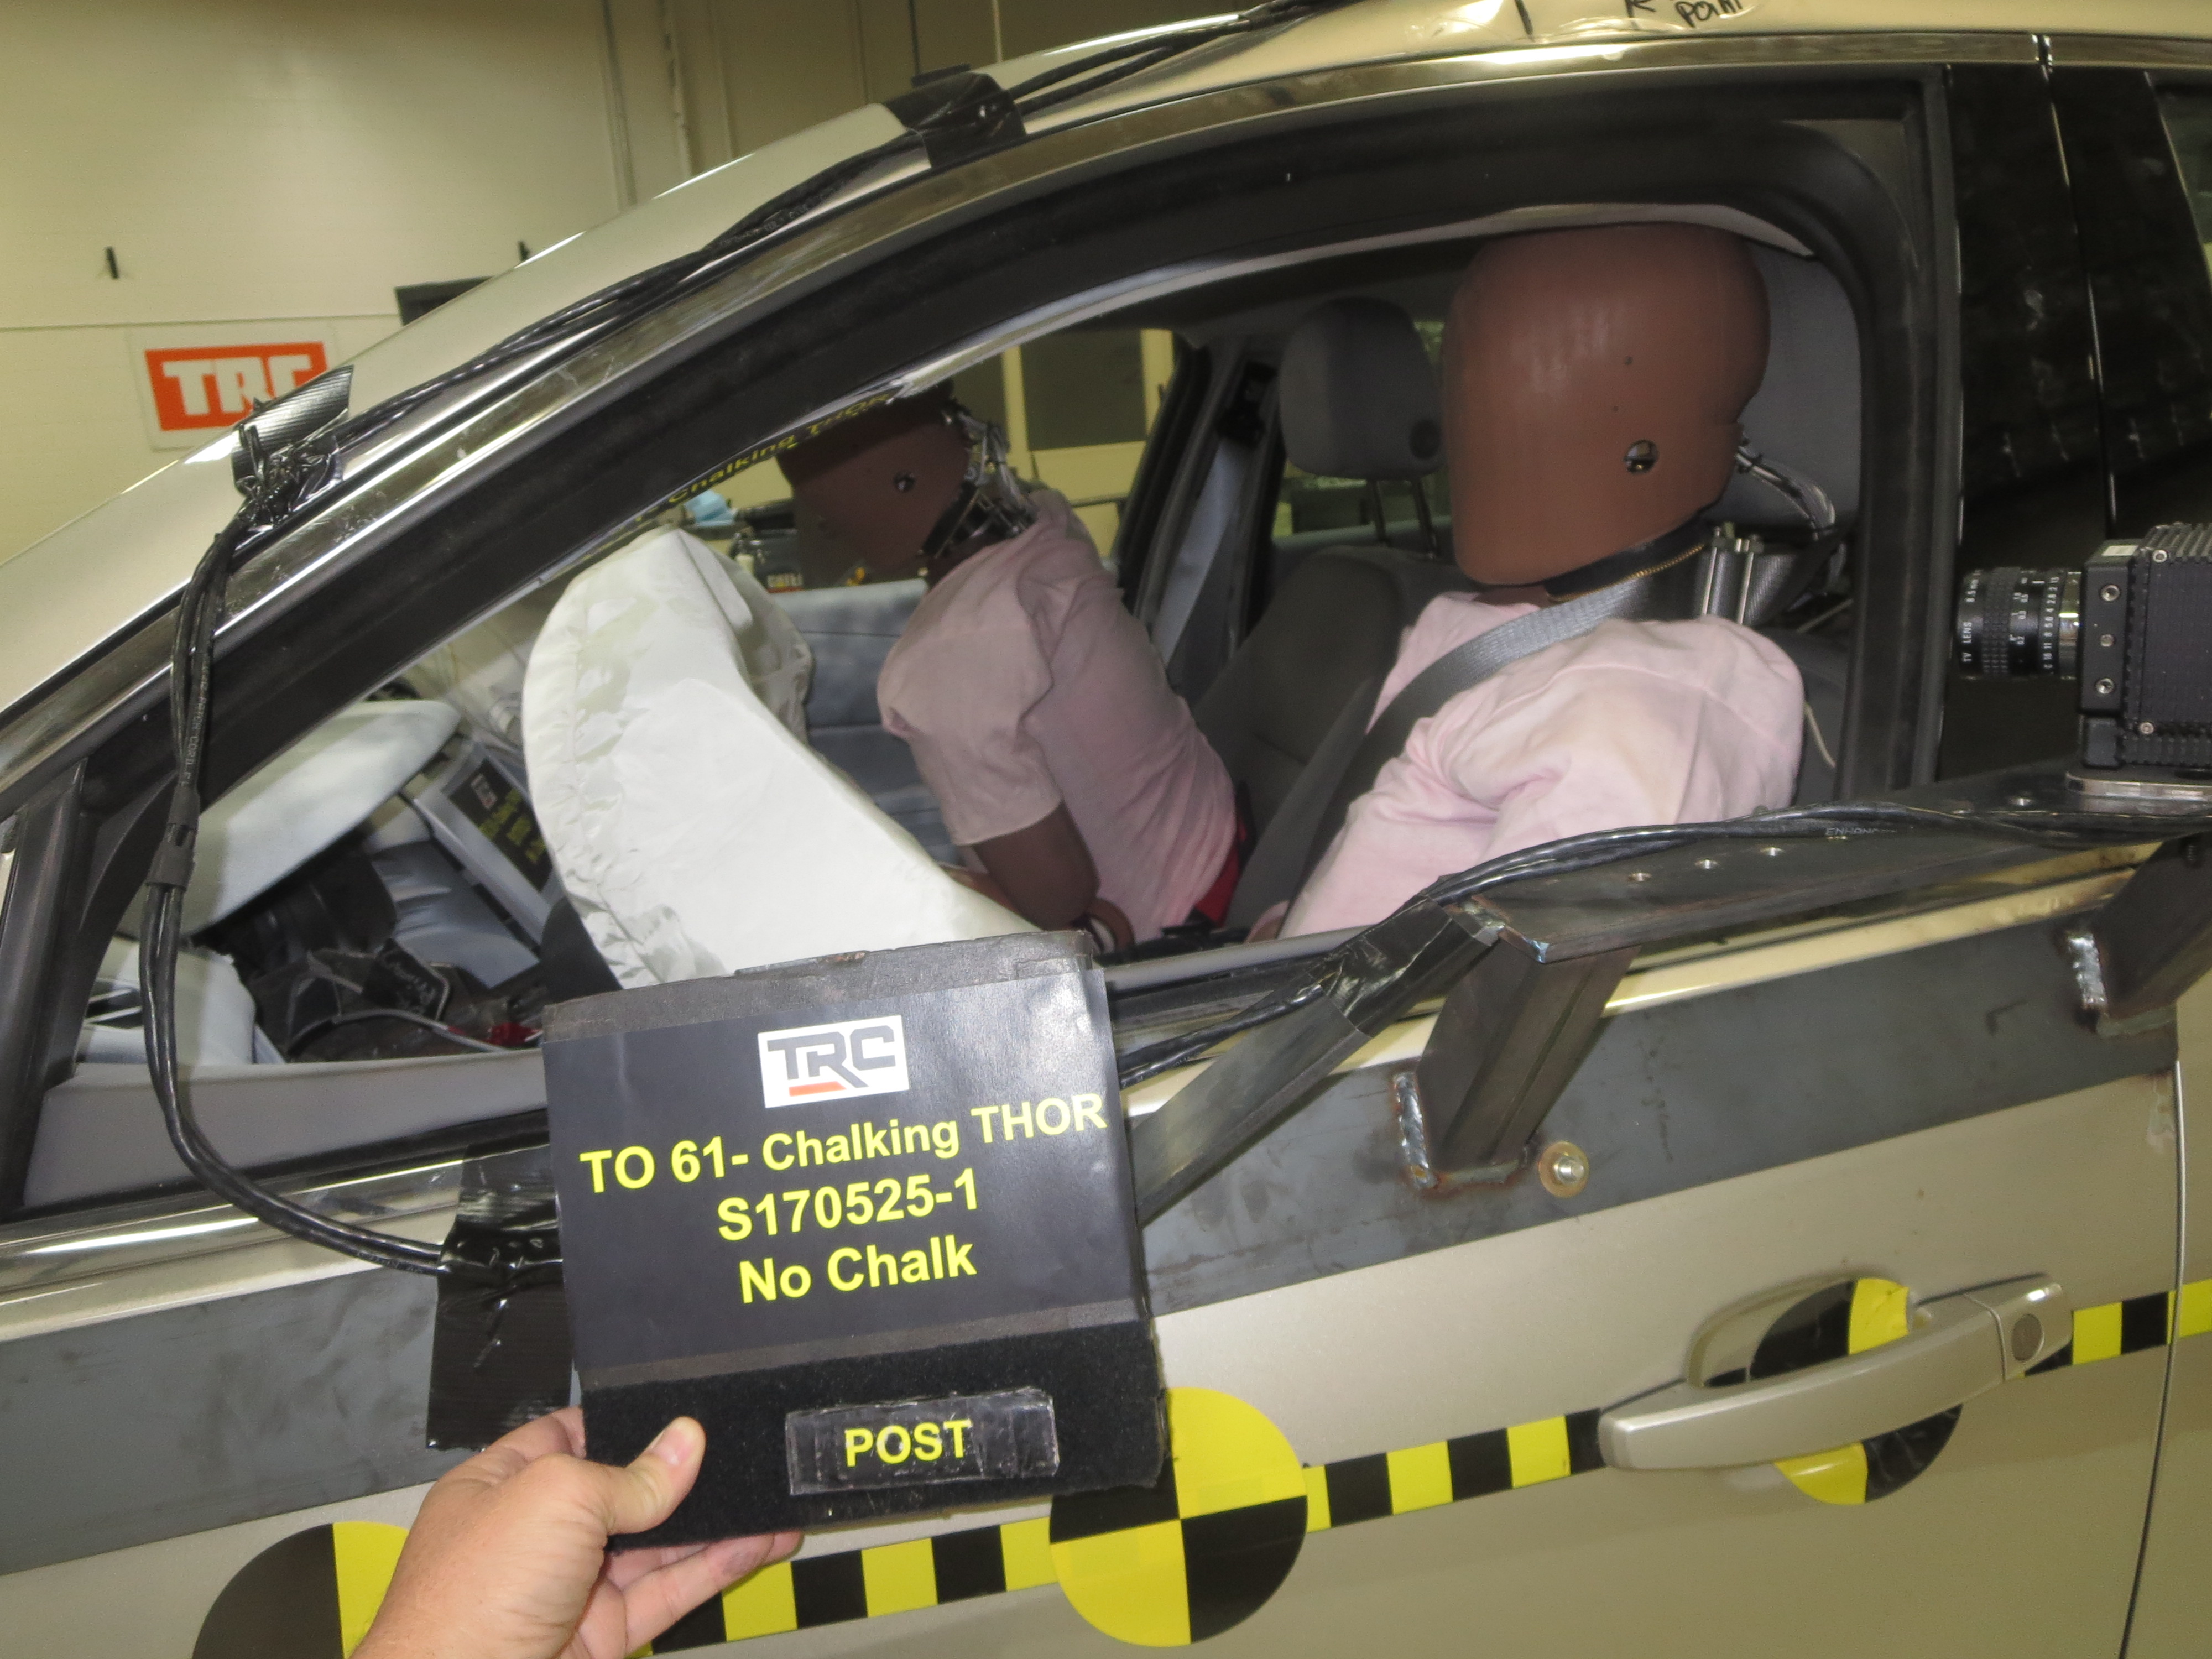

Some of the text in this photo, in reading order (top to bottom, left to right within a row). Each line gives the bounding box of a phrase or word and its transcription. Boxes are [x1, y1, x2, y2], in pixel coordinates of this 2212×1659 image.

[1962, 652, 1972, 662] TV
[1963, 622, 1972, 644] LENS
[767, 1025, 896, 1088] TRC
[580, 1093, 1108, 1193] TO 61- Chalking THOR
[718, 1168, 977, 1240] S170525-1
[740, 1234, 977, 1303] No Chalk
[844, 1418, 971, 1467] POST
